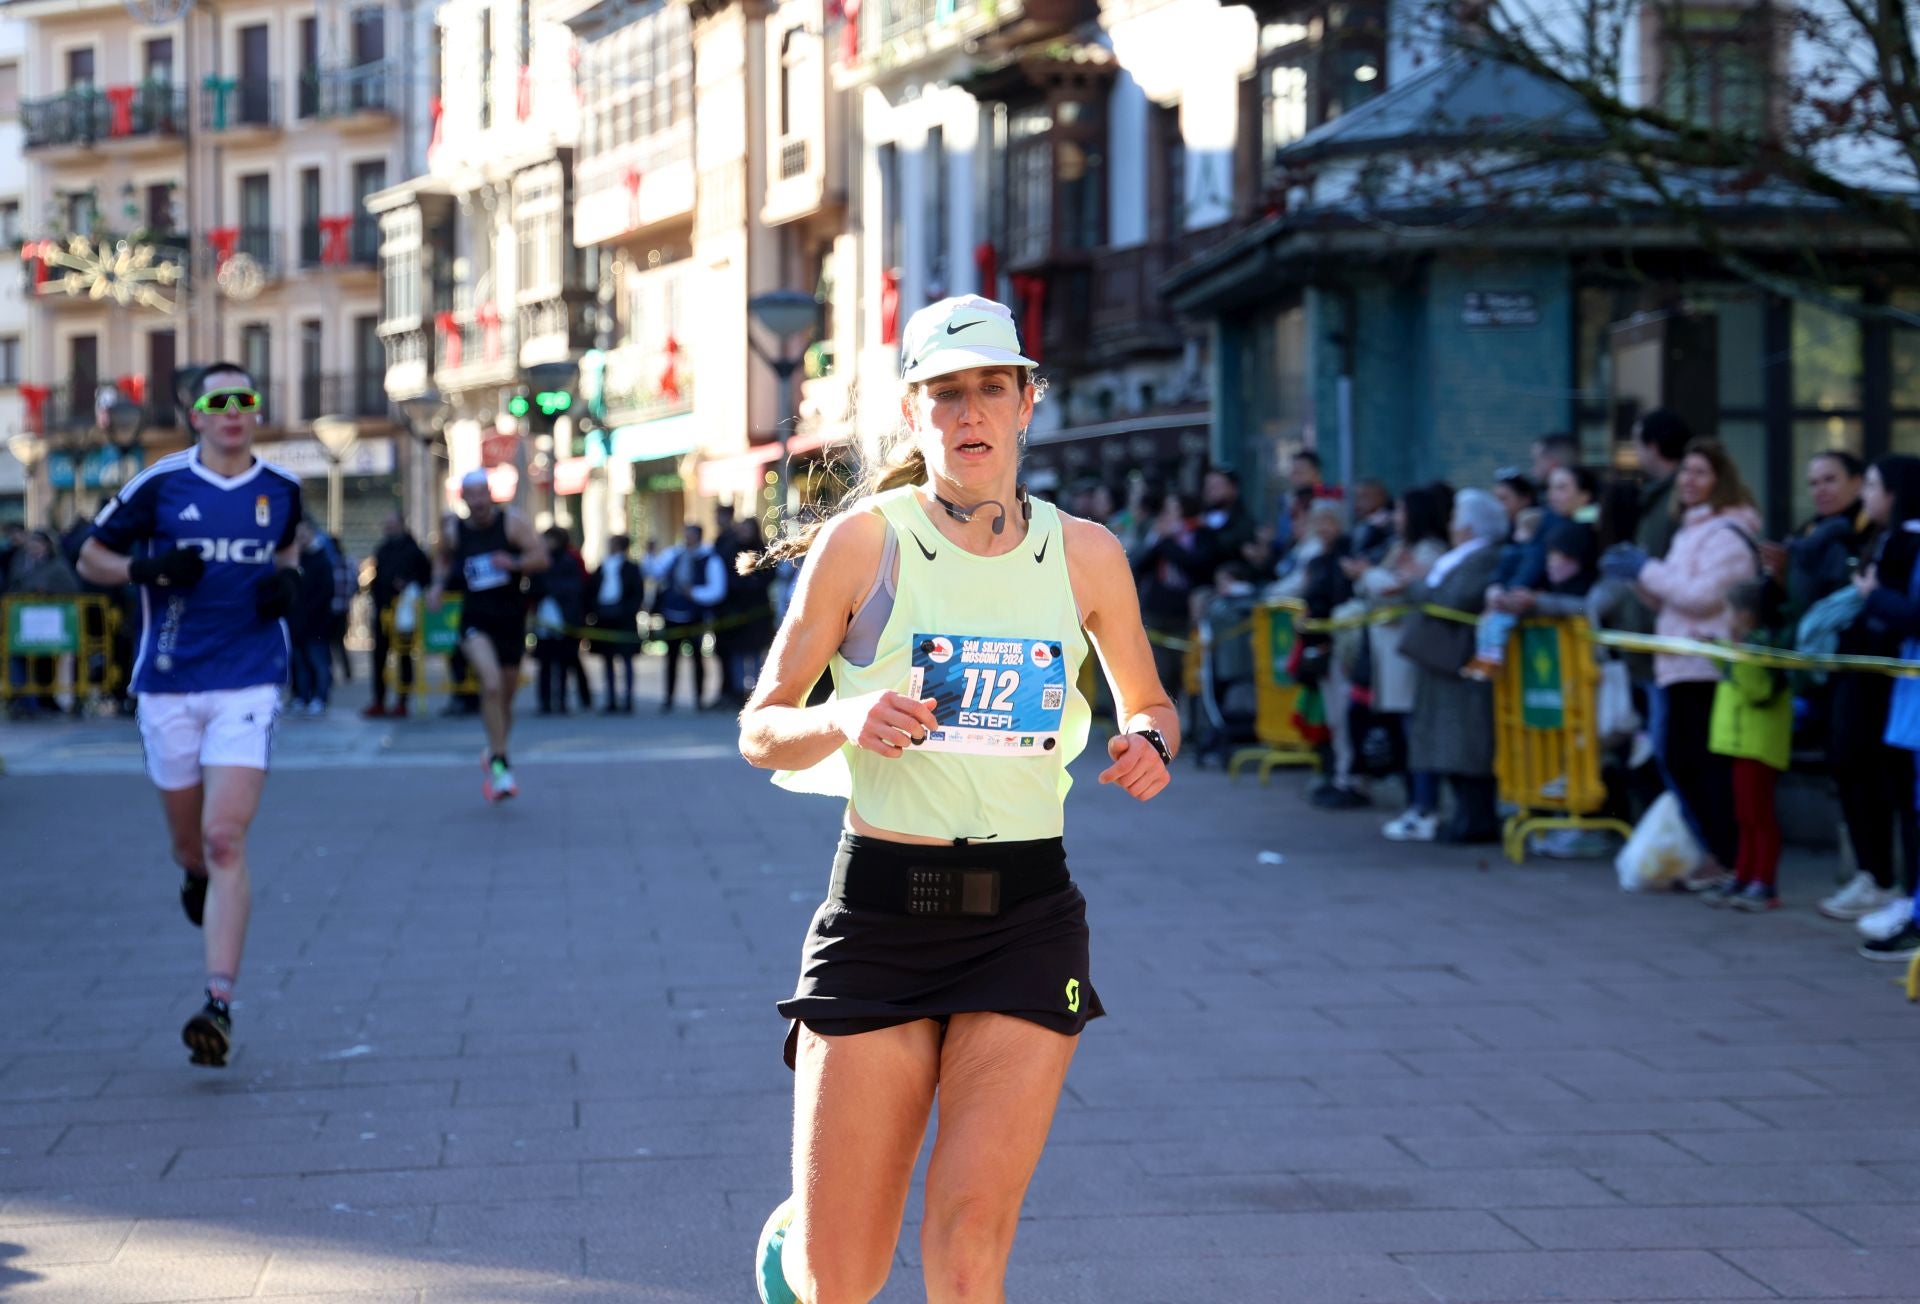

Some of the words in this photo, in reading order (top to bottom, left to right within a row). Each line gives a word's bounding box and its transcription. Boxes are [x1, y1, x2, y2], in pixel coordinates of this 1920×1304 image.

[962, 640, 979, 652] SAN
[982, 642, 1022, 654] SILVESTRE
[1002, 653, 1024, 665] 2024
[960, 668, 1020, 711] 112
[958, 711, 1012, 728] ESTEFI
